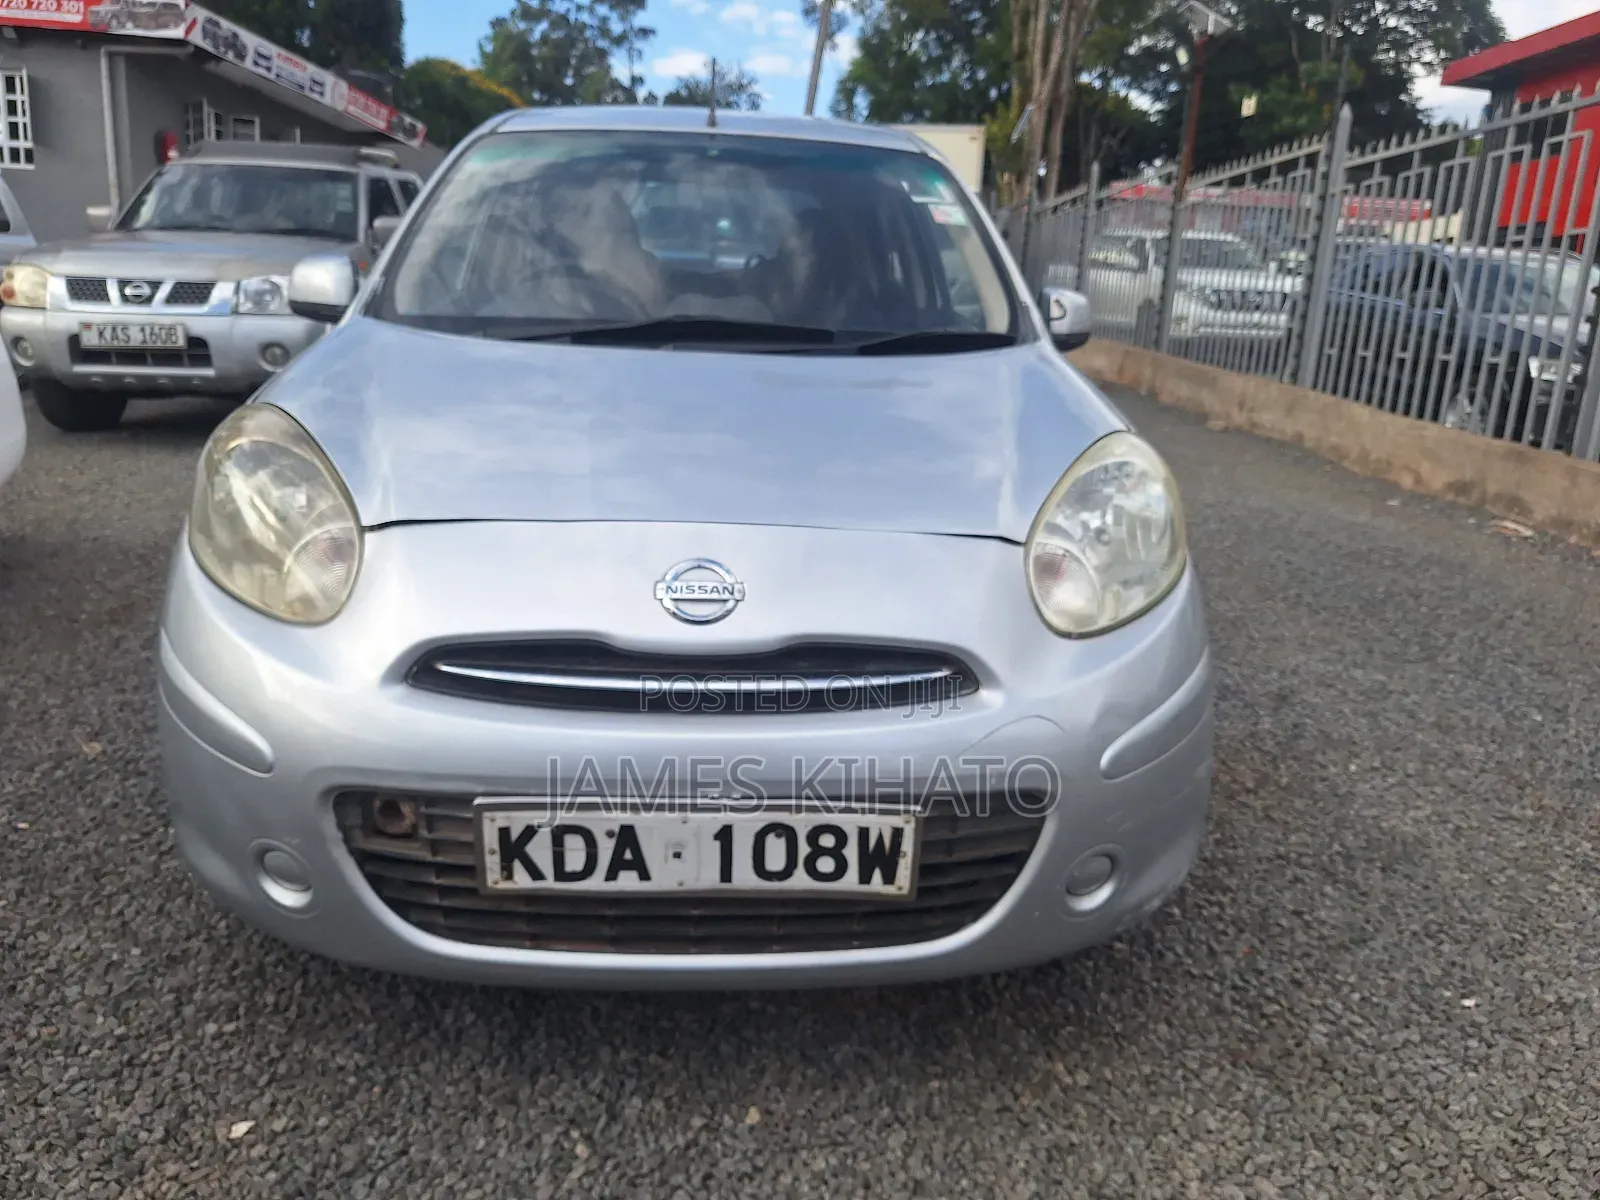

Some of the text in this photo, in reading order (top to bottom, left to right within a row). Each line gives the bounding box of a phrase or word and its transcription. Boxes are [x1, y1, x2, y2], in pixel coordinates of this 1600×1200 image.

[98, 325, 131, 344] KAS
[666, 585, 734, 596] NISSAN
[498, 822, 905, 886] KDA 108W
